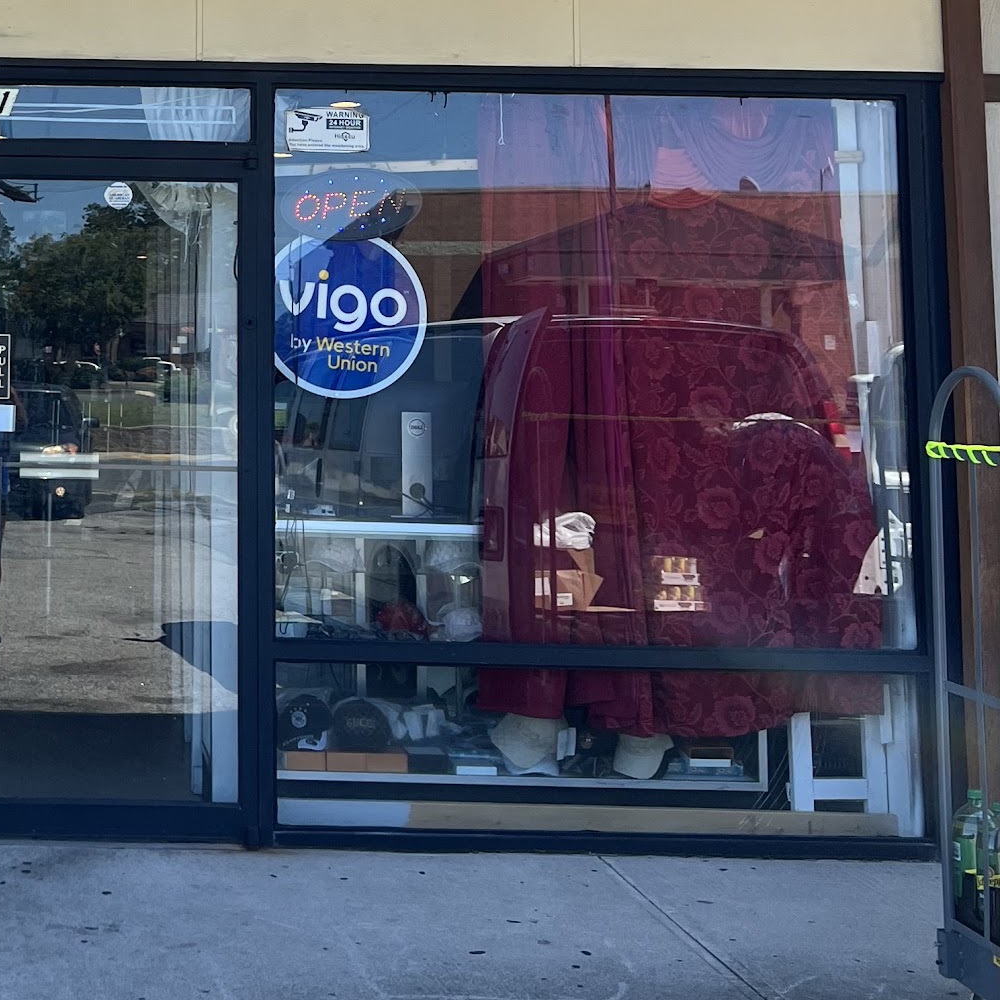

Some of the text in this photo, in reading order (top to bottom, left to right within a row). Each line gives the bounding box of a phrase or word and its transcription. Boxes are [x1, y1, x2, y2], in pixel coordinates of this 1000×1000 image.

[326, 111, 364, 119] WARNING
[294, 188, 407, 222] OPEN
[279, 269, 408, 333] vigo
[290, 333, 391, 357] by Western
[327, 354, 379, 373] Union
